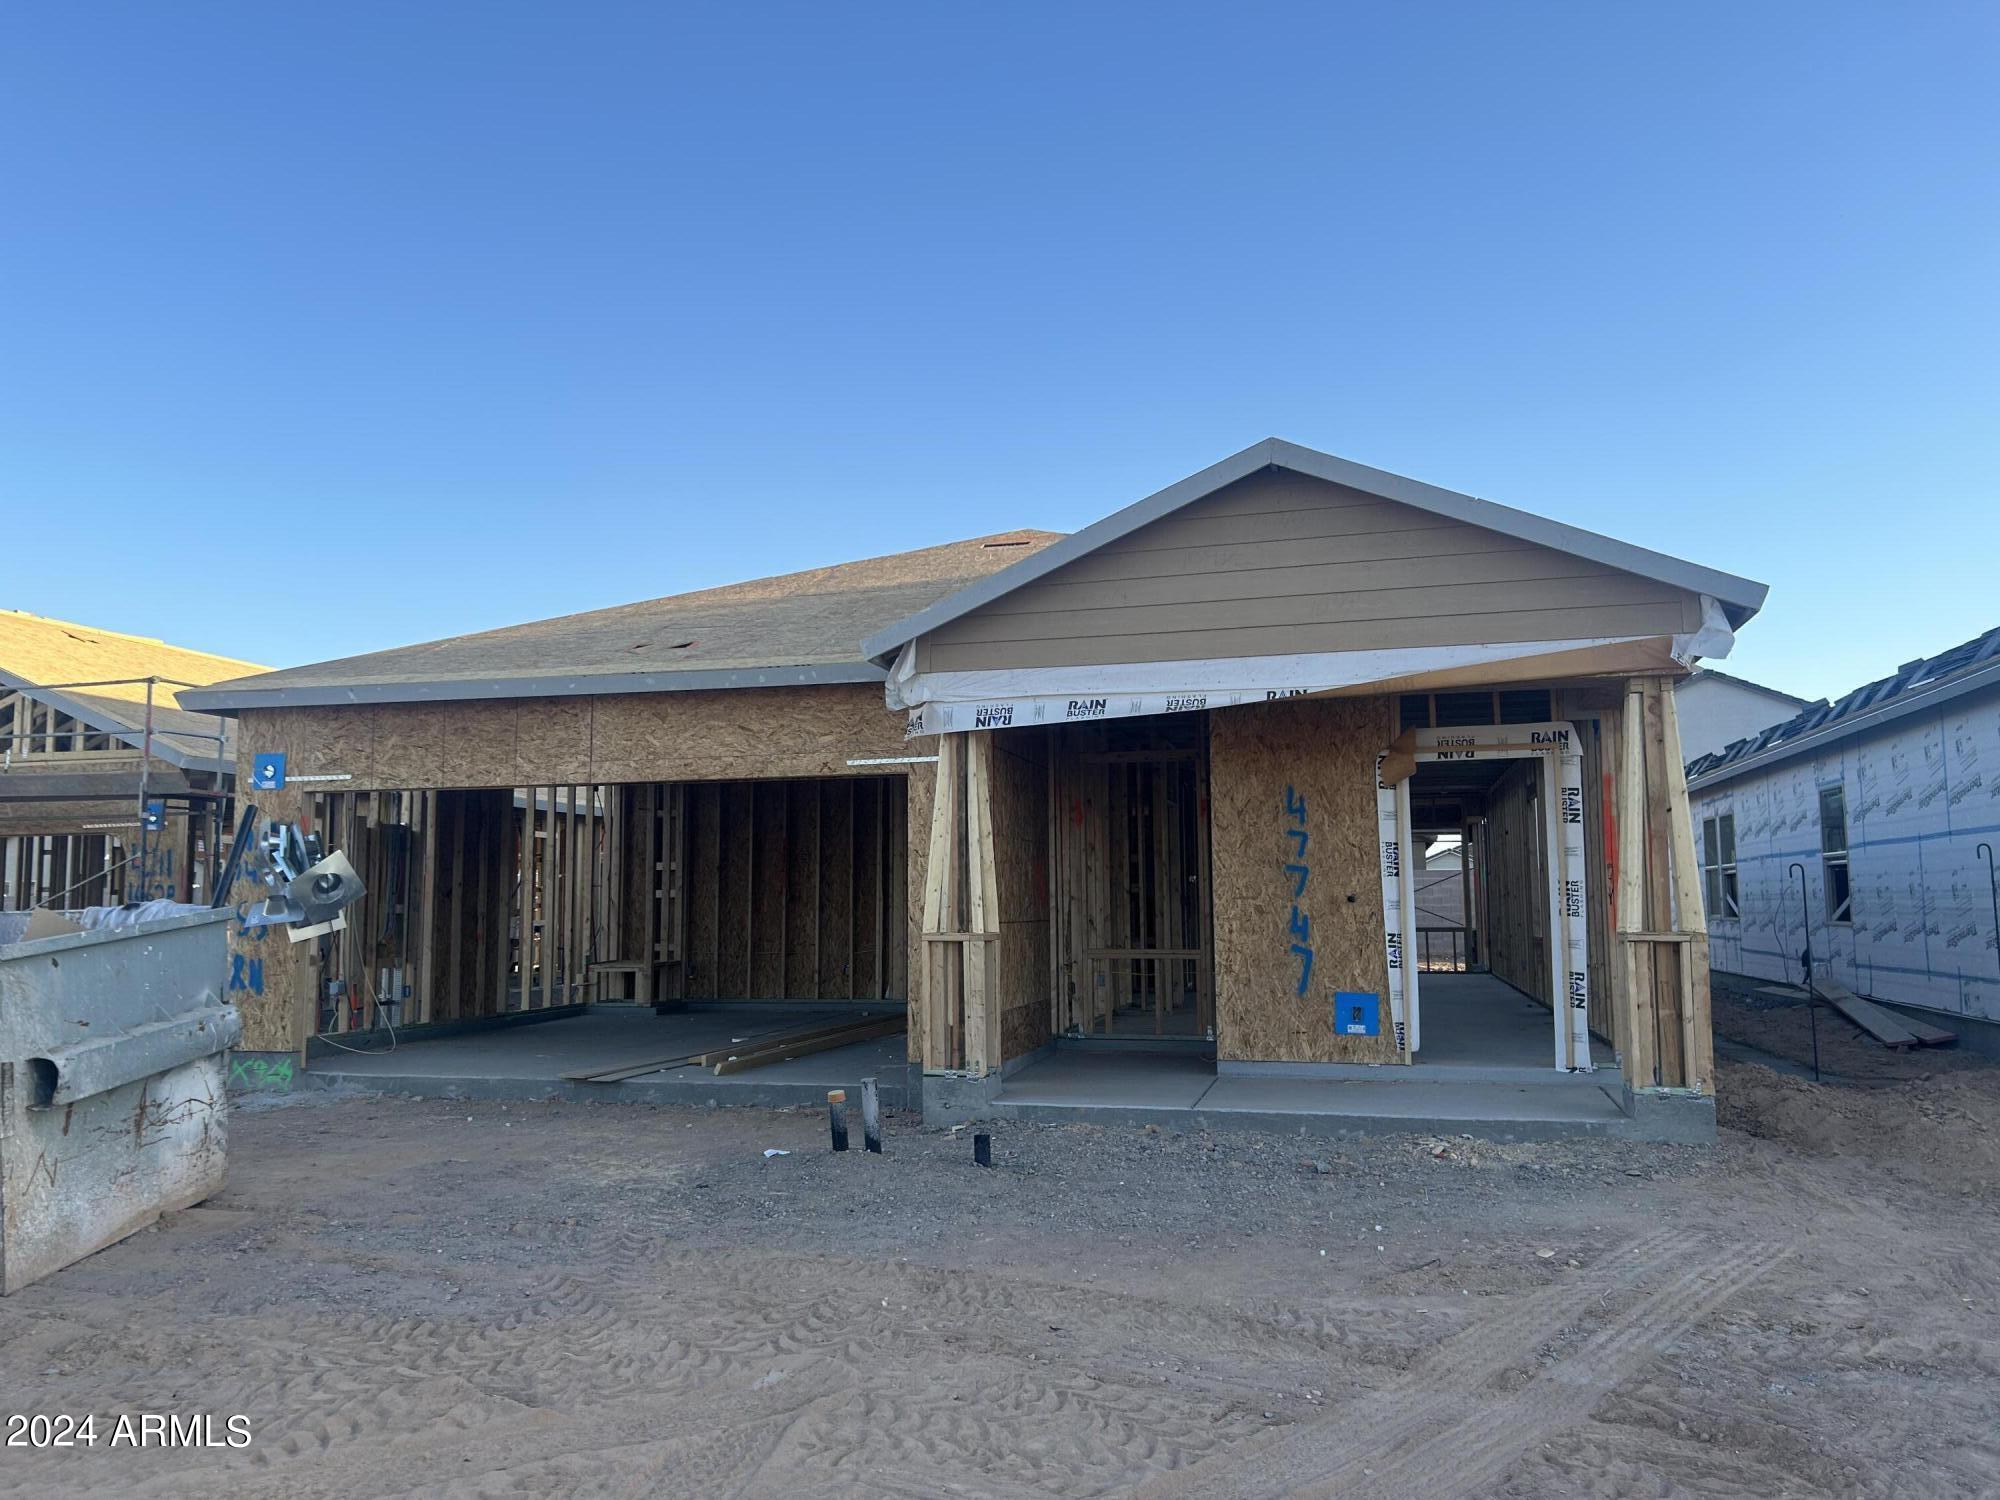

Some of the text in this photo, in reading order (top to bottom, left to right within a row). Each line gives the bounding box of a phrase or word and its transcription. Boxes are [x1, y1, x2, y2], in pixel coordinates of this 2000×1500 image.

[1068, 700, 1107, 711] RAIN
[1167, 698, 1207, 706] BUSTER
[976, 706, 1014, 716] BUSTER
[1066, 709, 1105, 717] BUSTER
[976, 715, 1012, 728] RAIN
[1531, 730, 1569, 743] RAIN
[1568, 787, 1580, 824] RAIN
[1385, 841, 1394, 877] BUSTER
[1571, 880, 1580, 917] BUSTER
[1387, 933, 1398, 968] RAIN
[1575, 971, 1586, 1009] RAIN
